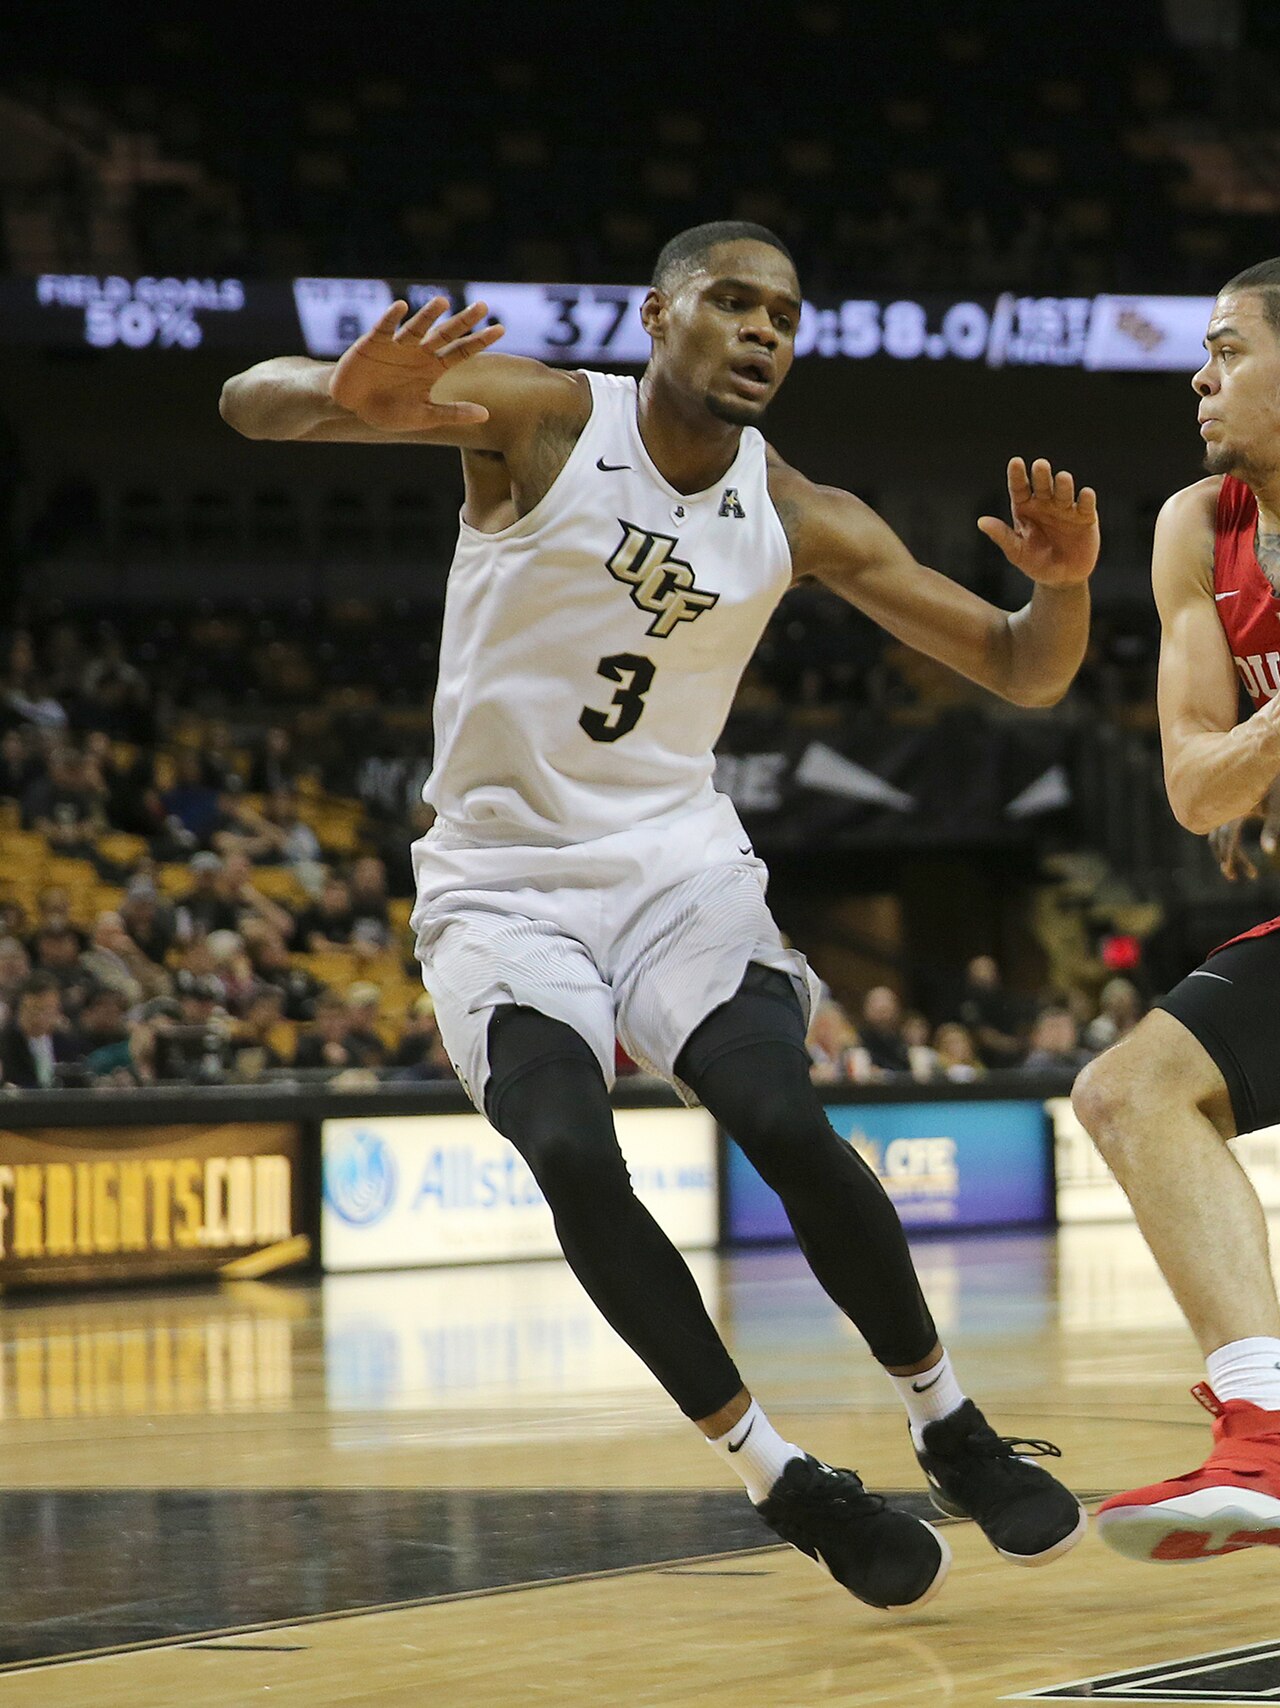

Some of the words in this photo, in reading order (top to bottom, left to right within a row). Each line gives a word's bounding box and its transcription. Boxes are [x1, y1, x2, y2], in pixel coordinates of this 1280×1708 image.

[37, 273, 132, 306] FIELD
[134, 276, 245, 312] GOALS
[85, 299, 203, 349] 50%
[546, 296, 631, 347] 37
[605, 517, 720, 638] UCF
[578, 653, 656, 742] 3
[885, 1136, 958, 1177] CFE
